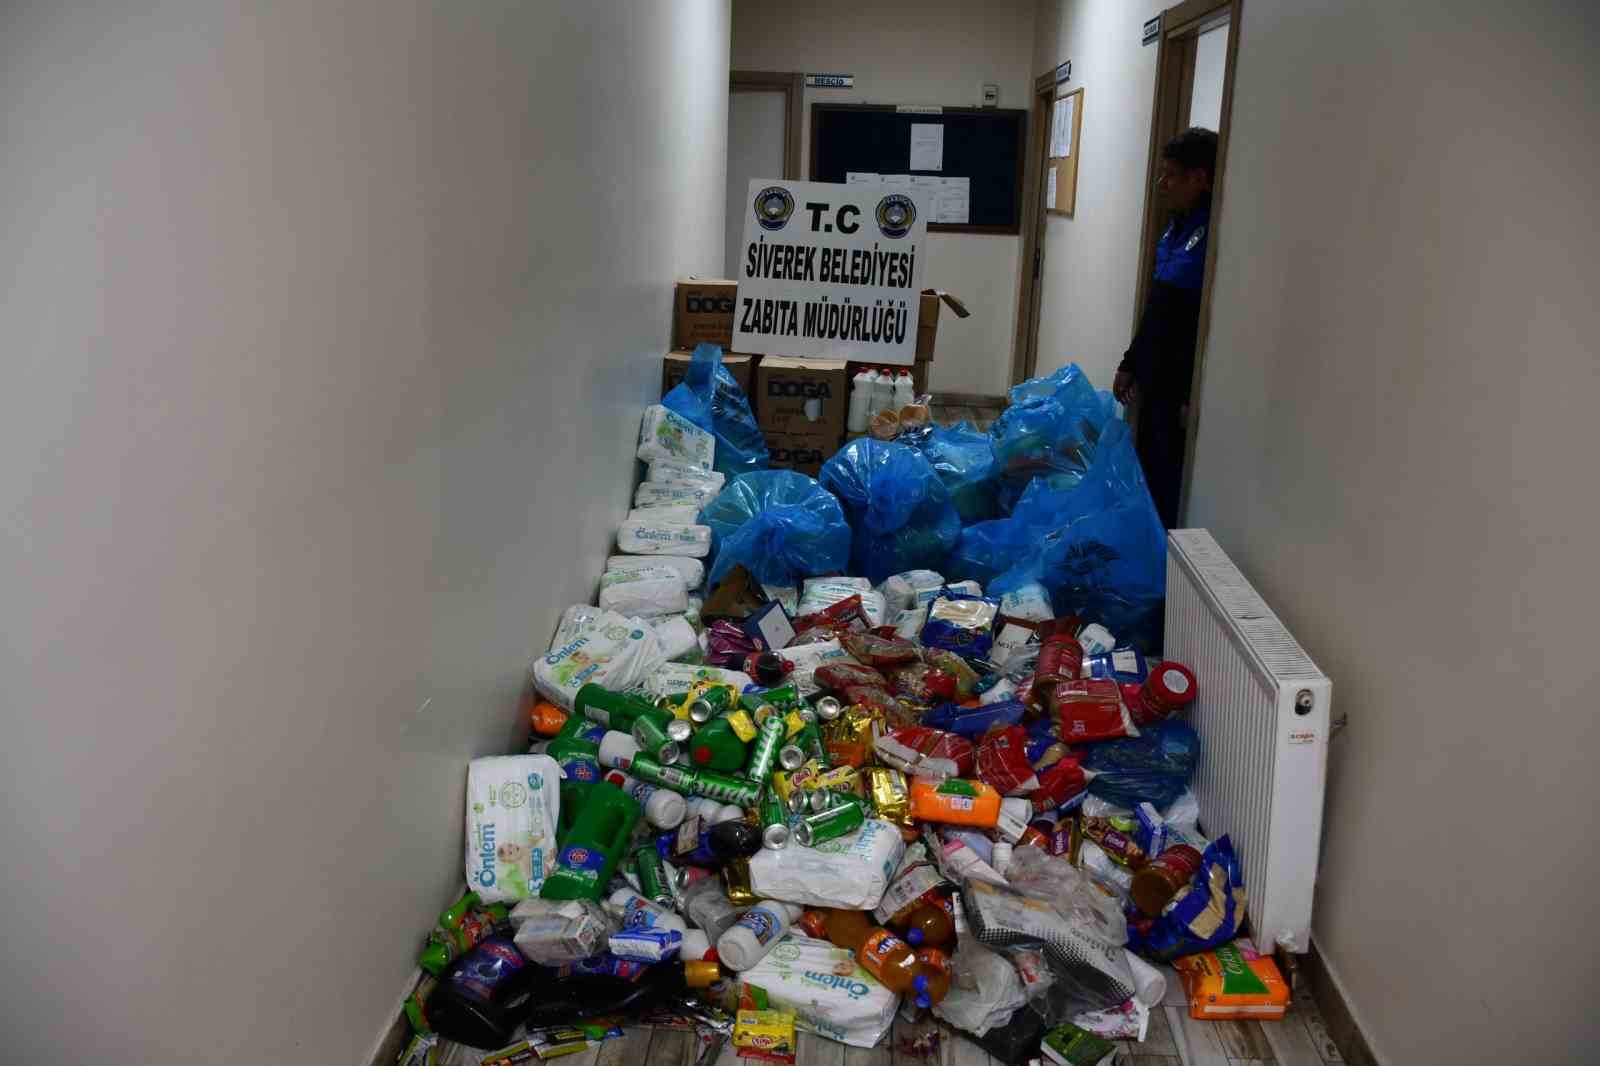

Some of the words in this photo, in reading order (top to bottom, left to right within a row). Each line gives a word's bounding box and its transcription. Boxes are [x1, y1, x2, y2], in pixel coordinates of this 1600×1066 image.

[806, 202, 861, 234] T.C
[746, 234, 816, 281] SİVEREK
[819, 242, 916, 288] BELEDİYESİ
[740, 297, 798, 337] ZABITA
[802, 295, 908, 345] MÜDÜRLÜĞÜ
[474, 822, 496, 888] Önlem
[804, 969, 870, 1000] Önlem
